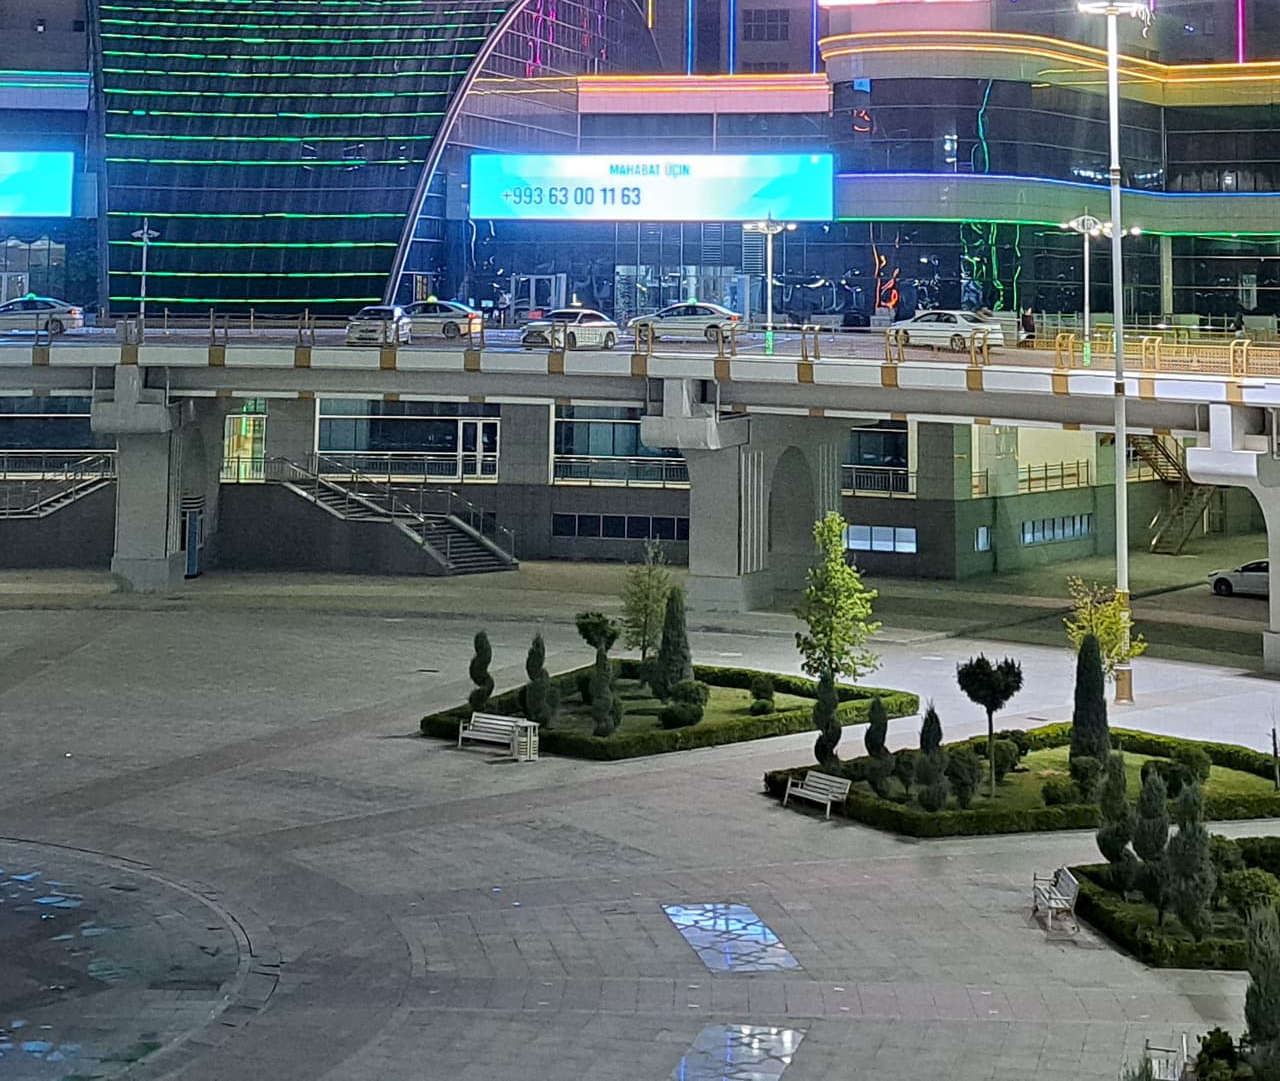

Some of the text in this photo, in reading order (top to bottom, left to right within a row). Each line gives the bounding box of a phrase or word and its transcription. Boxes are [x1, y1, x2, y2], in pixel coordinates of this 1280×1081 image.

[609, 163, 660, 176] MAHABAT
[502, 186, 641, 206] +993 63 00 11 63
